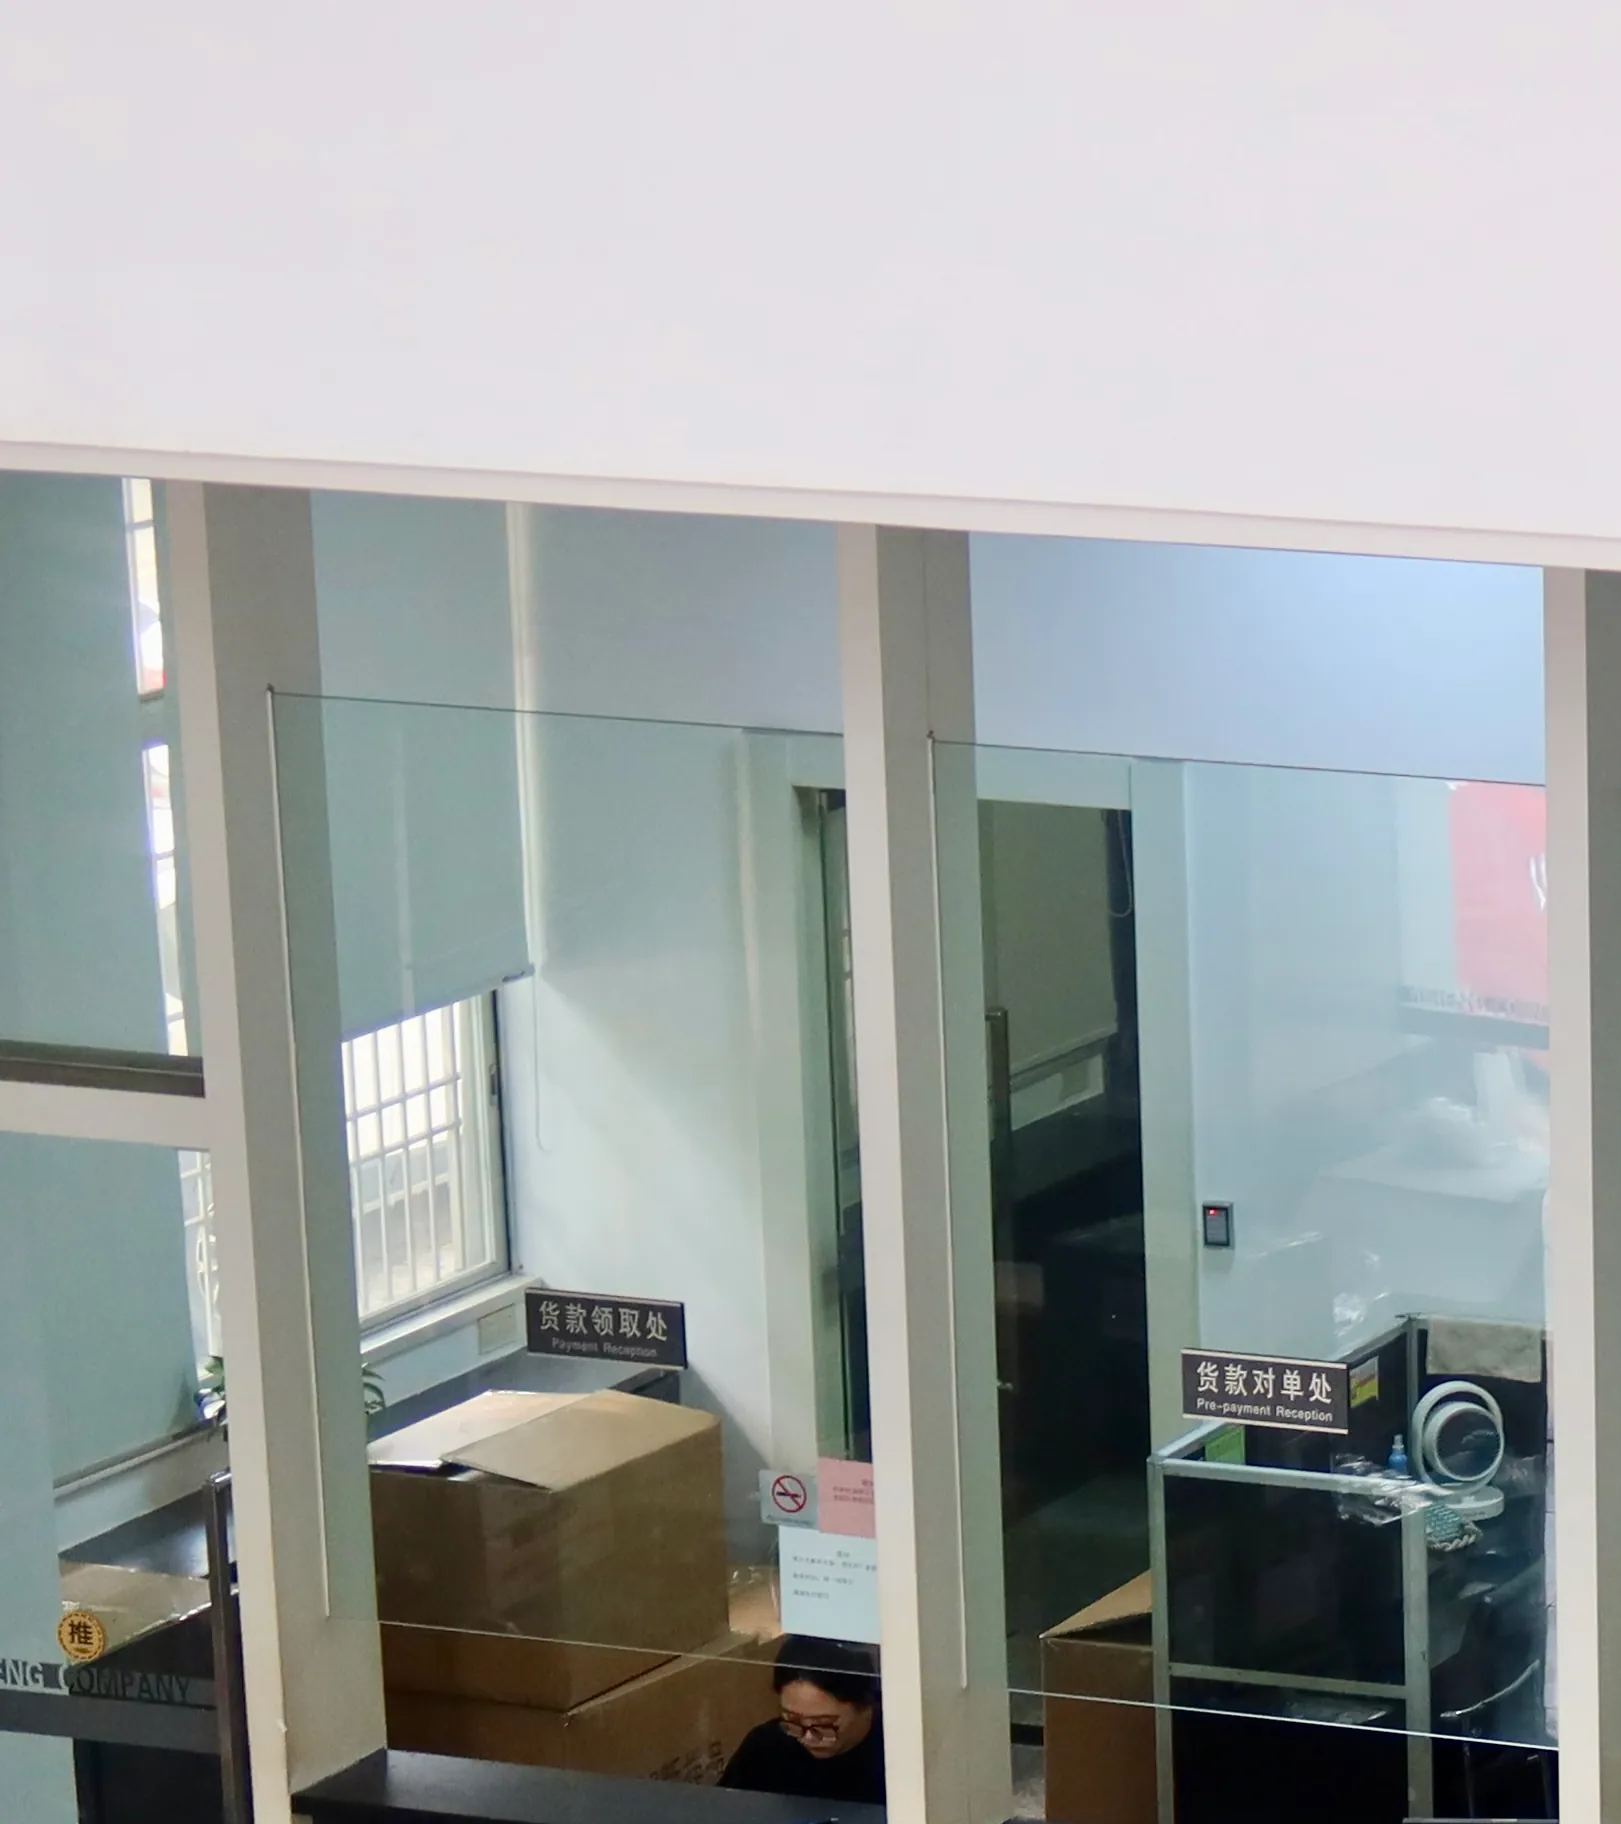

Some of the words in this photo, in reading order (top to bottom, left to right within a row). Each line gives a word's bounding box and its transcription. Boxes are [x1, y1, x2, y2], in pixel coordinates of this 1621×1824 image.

[539, 1300, 668, 1342] 货款领取处
[552, 1337, 599, 1353] Payment
[603, 1342, 658, 1358] Reception
[1197, 1361, 1333, 1404] 货款对单处
[1197, 1398, 1271, 1416] Pre-payment
[1276, 1406, 1333, 1422] Reception
[69, 1621, 94, 1646] 推
[59, 1662, 190, 1703] COMPANY
